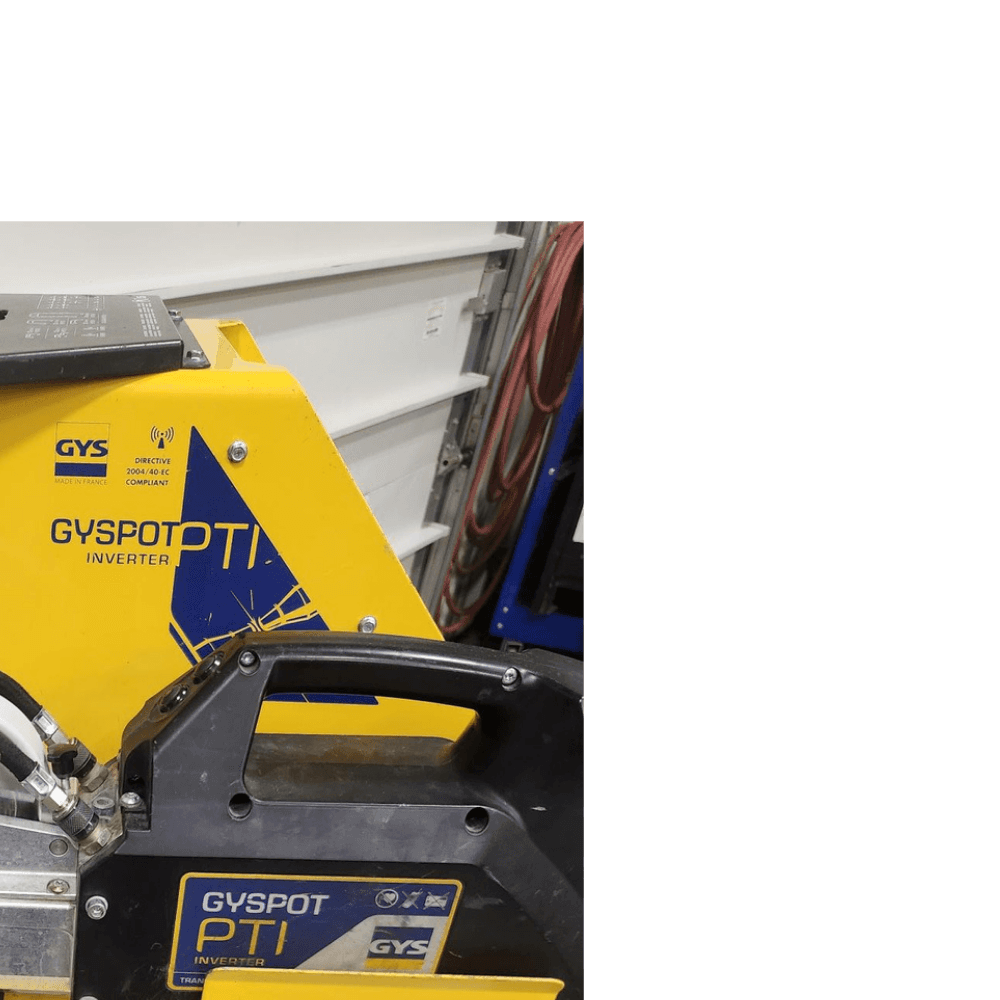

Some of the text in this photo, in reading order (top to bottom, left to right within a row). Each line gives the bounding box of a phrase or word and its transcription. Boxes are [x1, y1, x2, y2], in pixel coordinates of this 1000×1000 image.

[55, 439, 108, 457] GYS
[51, 519, 261, 570] GYSPOT PTI
[87, 552, 170, 565] INVERTER
[202, 892, 330, 916] GYSPOT
[196, 917, 288, 956] PTI
[367, 939, 430, 955] GYS
[194, 956, 265, 967] INVERTER
